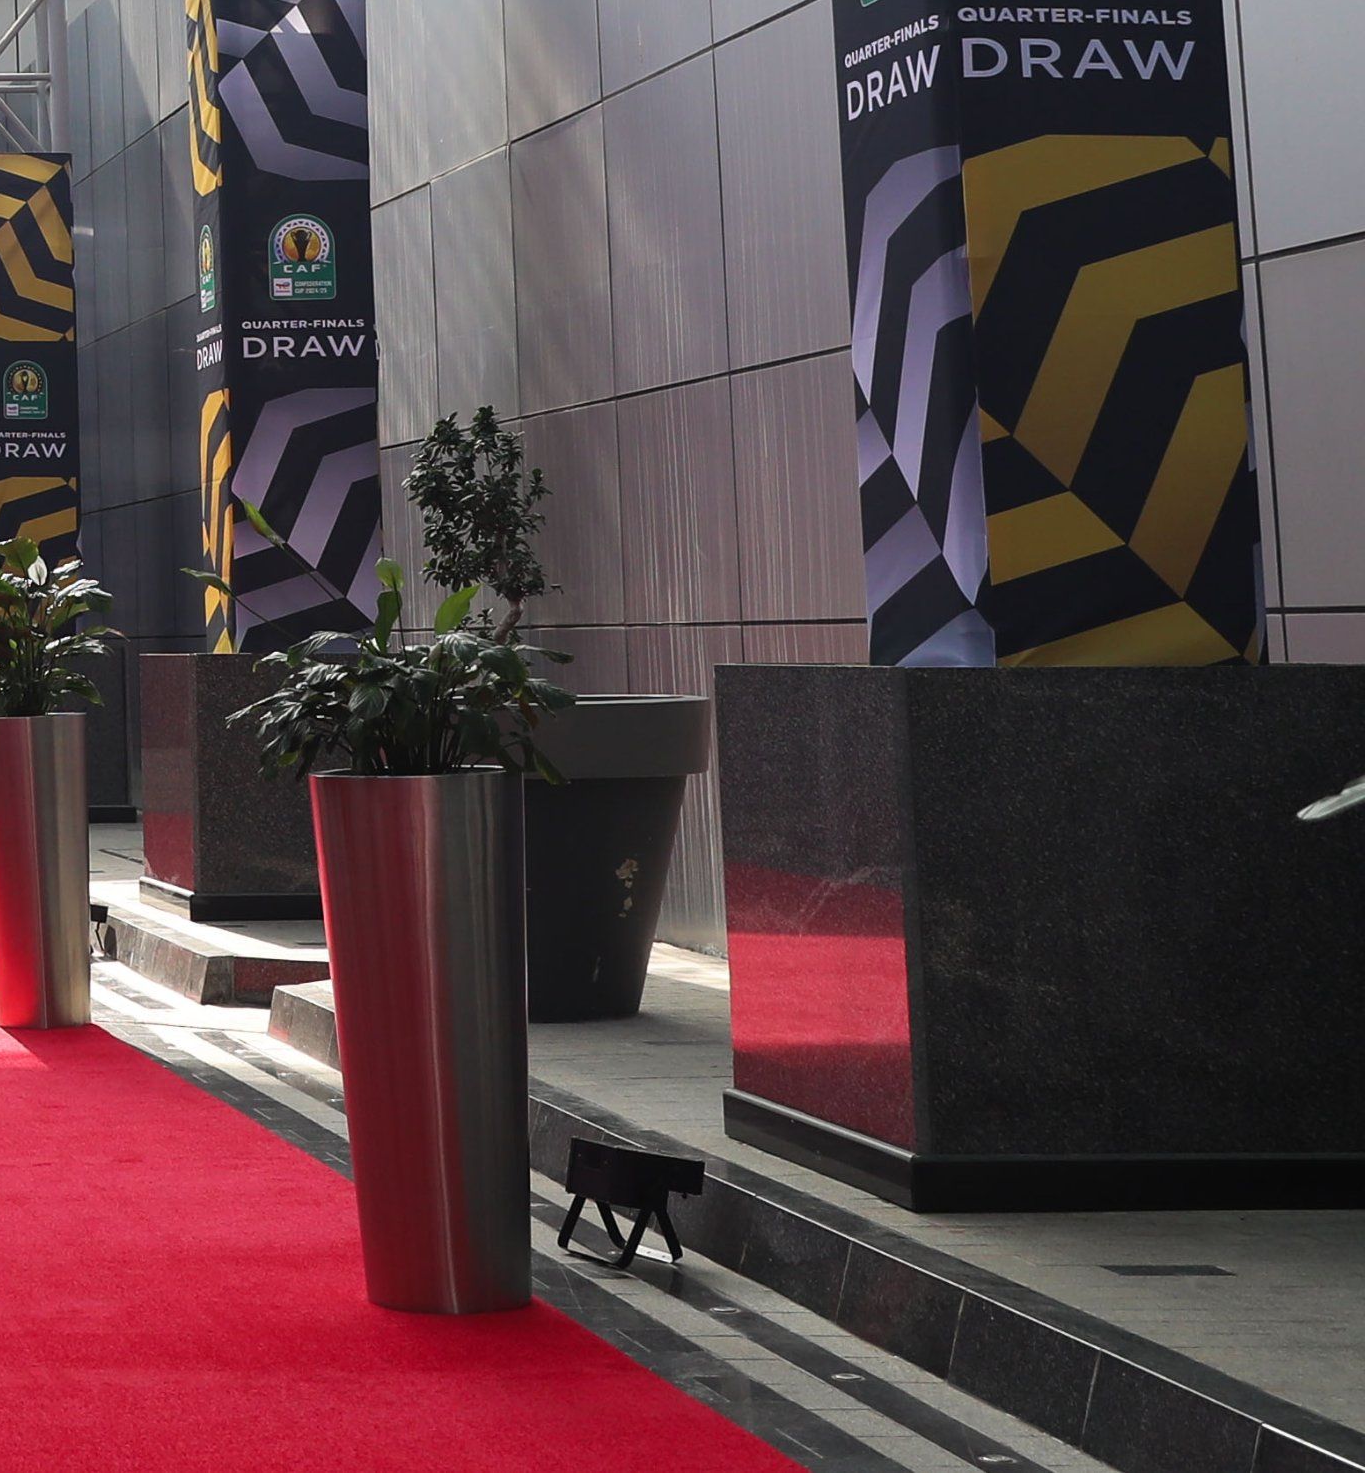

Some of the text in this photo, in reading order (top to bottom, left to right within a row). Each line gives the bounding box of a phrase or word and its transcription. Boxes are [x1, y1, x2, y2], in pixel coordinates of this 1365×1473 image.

[957, 7, 1193, 25] QUARTER-FINALS
[844, 15, 939, 68] QUARTER-FINALS
[961, 37, 1196, 80] DRAW
[846, 44, 941, 121] DRAW
[283, 264, 321, 273] CAF
[242, 319, 365, 329] QUARTER-FINALS
[196, 339, 223, 371] DRAW
[242, 334, 366, 359] DRAW
